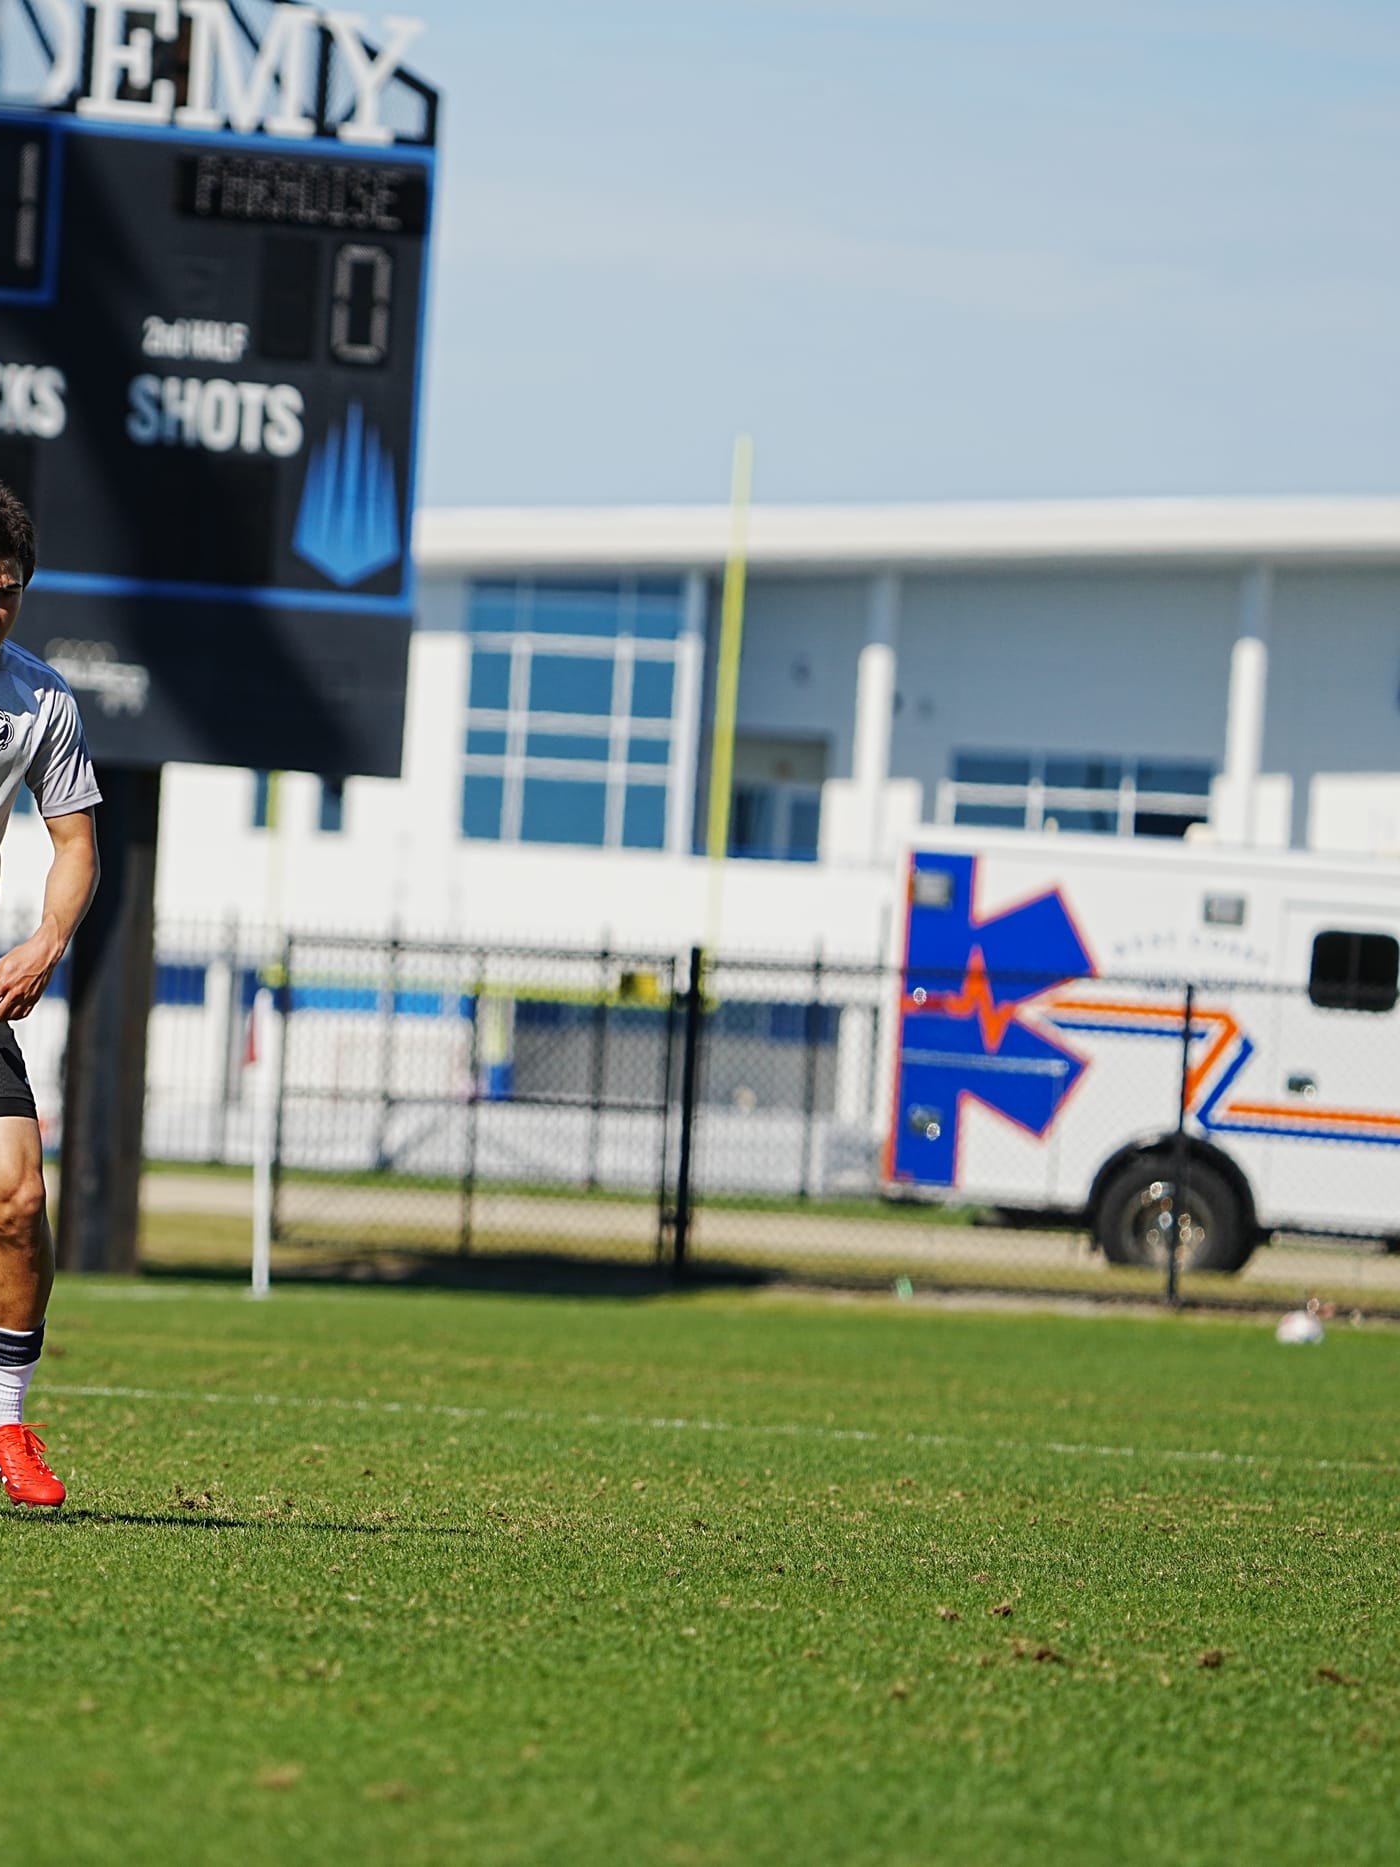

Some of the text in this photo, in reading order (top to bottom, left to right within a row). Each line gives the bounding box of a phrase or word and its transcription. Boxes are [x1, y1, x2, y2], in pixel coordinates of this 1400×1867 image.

[189, 319, 249, 363] HALF
[330, 243, 393, 364] 0
[126, 374, 304, 457] SHOTS
